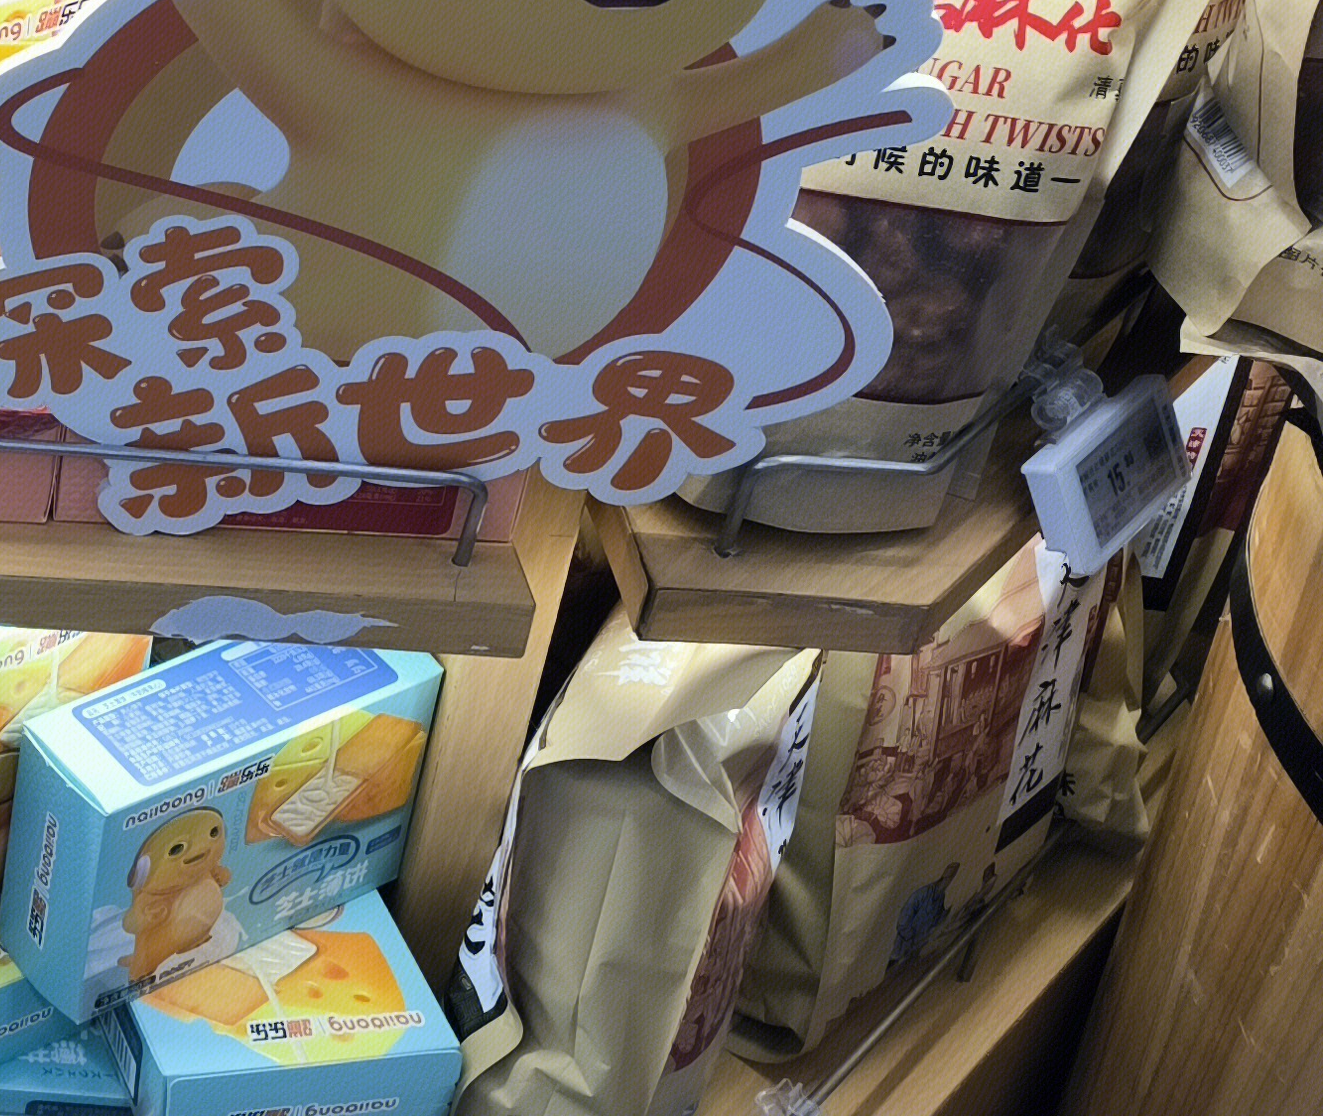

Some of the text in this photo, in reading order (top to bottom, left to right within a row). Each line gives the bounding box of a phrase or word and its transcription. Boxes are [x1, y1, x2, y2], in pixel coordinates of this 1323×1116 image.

[910, 56, 1013, 100] UGAR
[980, 112, 1106, 158] TWISTS
[109, 345, 736, 520] 新世界
